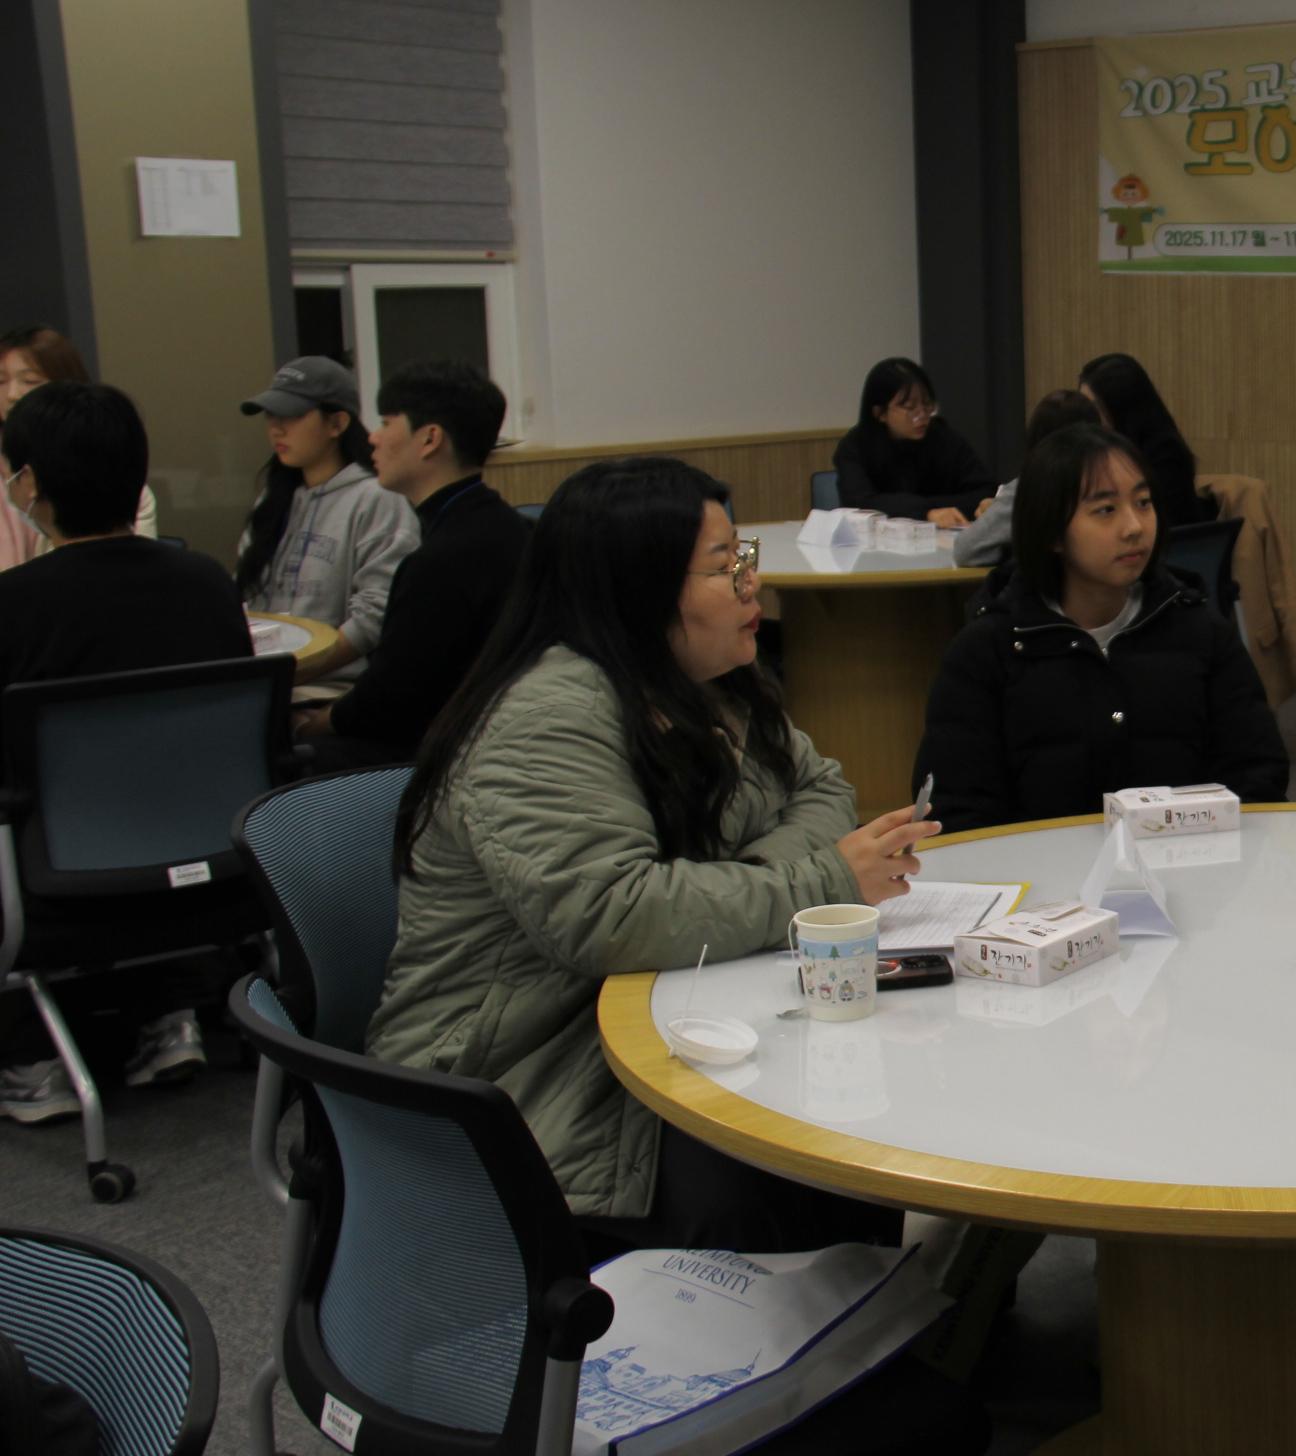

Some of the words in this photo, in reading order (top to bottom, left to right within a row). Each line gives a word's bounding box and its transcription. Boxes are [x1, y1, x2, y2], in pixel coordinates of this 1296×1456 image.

[1119, 68, 1229, 118] 2025
[1164, 230, 1247, 247] 2025.11.17
[1252, 231, 1266, 247] 월
[662, 1254, 756, 1294] UNIVERSITY
